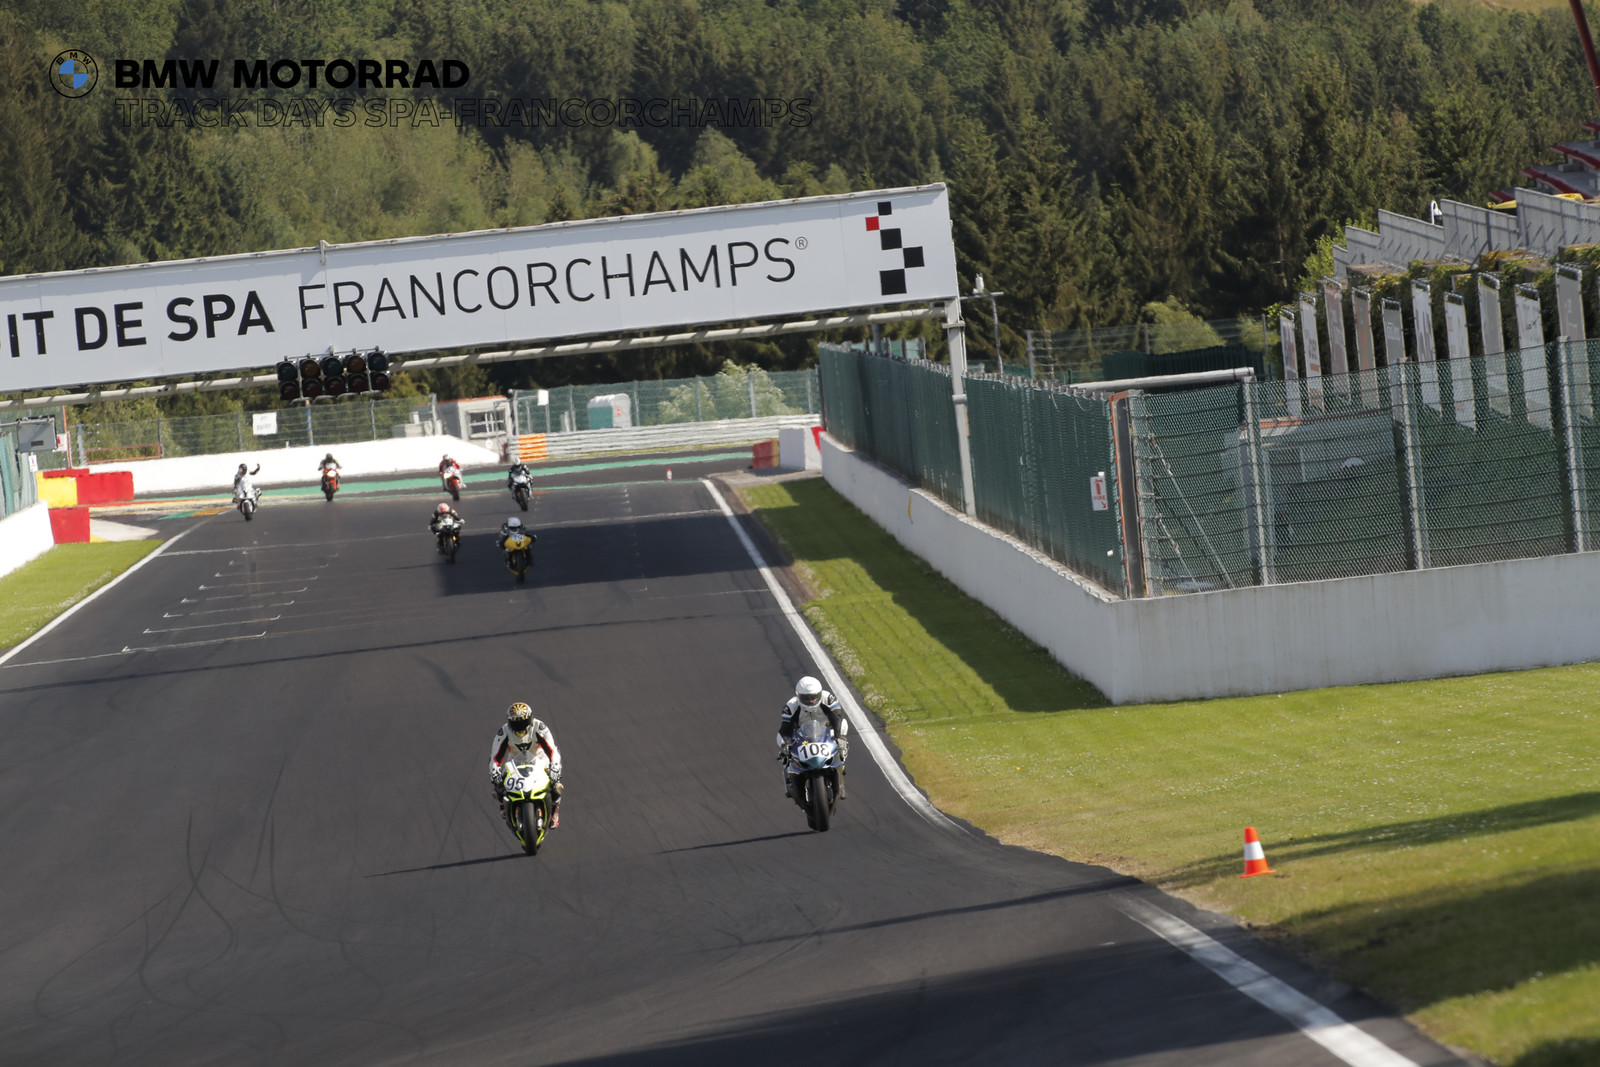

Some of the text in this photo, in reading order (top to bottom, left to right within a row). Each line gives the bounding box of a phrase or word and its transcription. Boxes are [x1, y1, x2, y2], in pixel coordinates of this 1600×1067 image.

[0, 310, 54, 358] IT
[74, 301, 147, 351] DE
[166, 290, 275, 342] SPA
[800, 743, 830, 759] 108
[506, 777, 525, 790] 95
